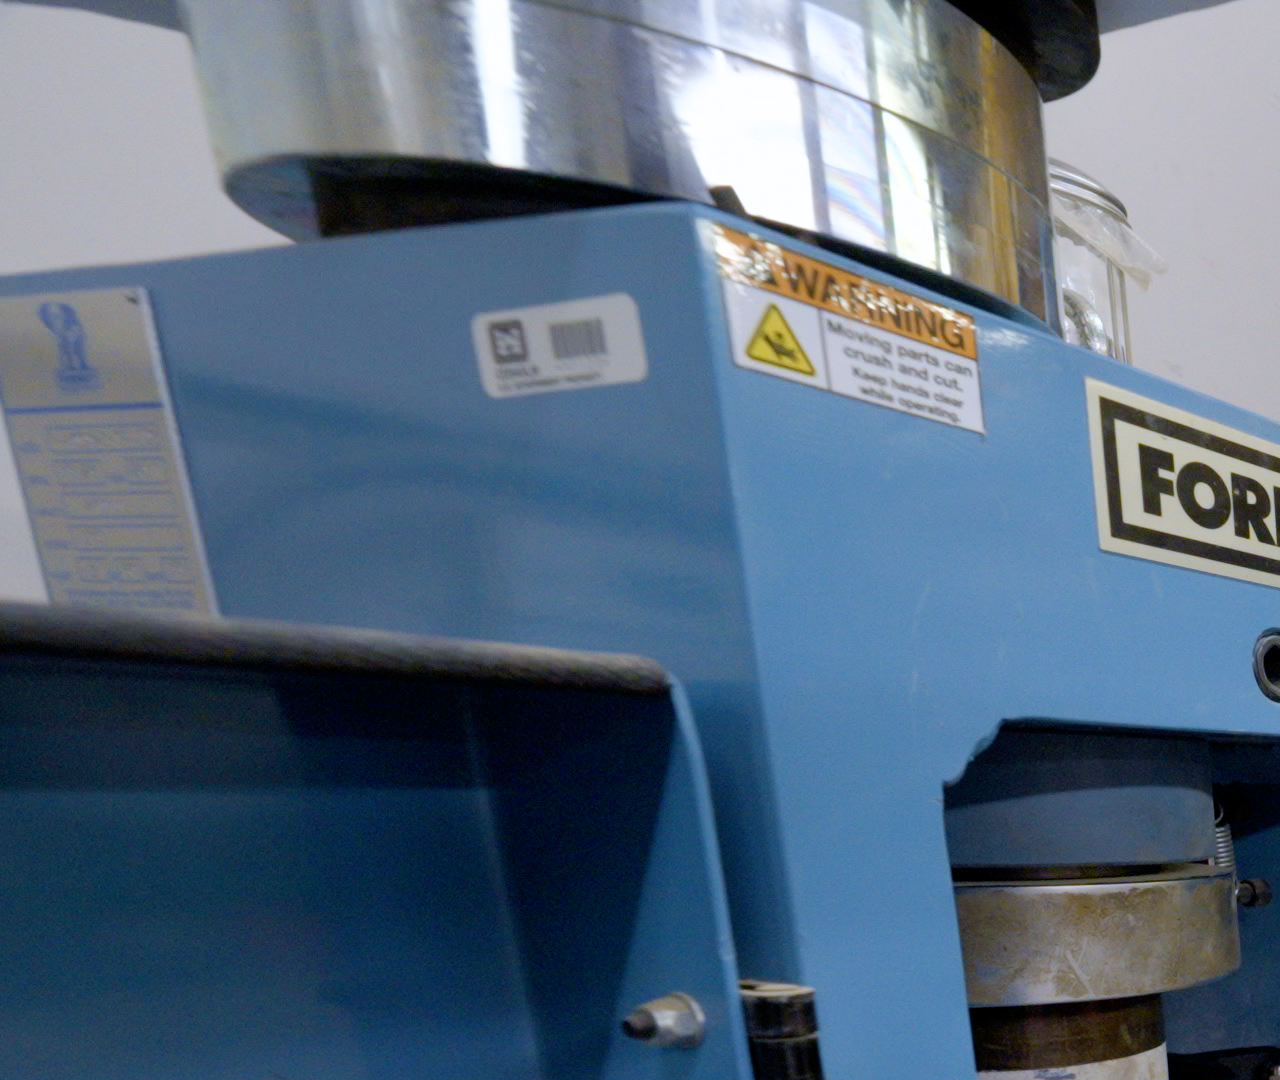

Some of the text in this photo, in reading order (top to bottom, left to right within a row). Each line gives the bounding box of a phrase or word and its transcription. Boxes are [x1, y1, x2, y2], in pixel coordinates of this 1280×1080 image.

[783, 257, 966, 351] WARNING
[827, 318, 974, 378] Moving parts can
[843, 345, 894, 371] crush
[898, 358, 930, 382] and
[853, 366, 888, 389] Keep
[892, 377, 931, 401] hands
[860, 384, 894, 404] while
